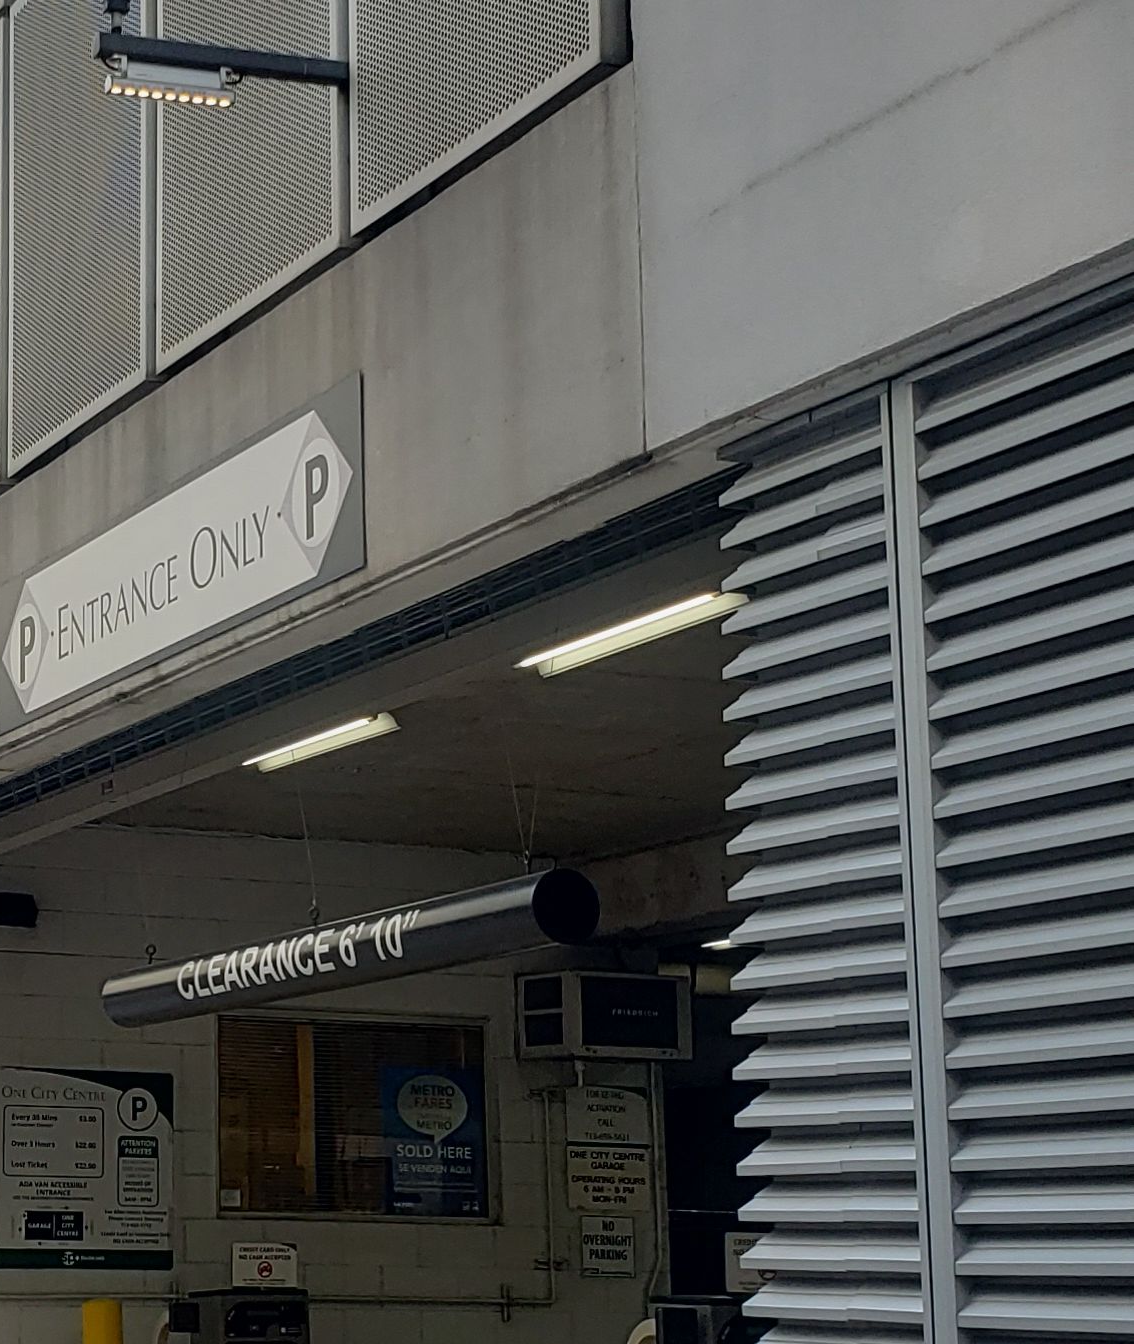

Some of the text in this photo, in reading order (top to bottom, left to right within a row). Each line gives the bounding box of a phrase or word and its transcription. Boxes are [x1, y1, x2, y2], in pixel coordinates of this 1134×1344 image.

[304, 454, 329, 541] P
[58, 505, 270, 661] ENTRANCE ONLY
[19, 615, 36, 685] P
[177, 928, 336, 1000] CLEARANCE
[2, 1086, 106, 1102] ONE CITY CENTRE
[410, 1084, 455, 1097] METRO
[132, 1096, 147, 1121] P
[415, 1097, 452, 1109] FARES
[11, 1113, 30, 1123] Every
[11, 1140, 28, 1149] Over
[396, 1144, 473, 1159] SOLD HERE
[612, 1152, 645, 1161] CENTRE
[11, 1161, 25, 1169] Lost
[27, 1161, 48, 1170] Ticket
[602, 1220, 614, 1231] NO
[583, 1234, 632, 1246] OVERNIGHT
[589, 1249, 627, 1260] PARKING
